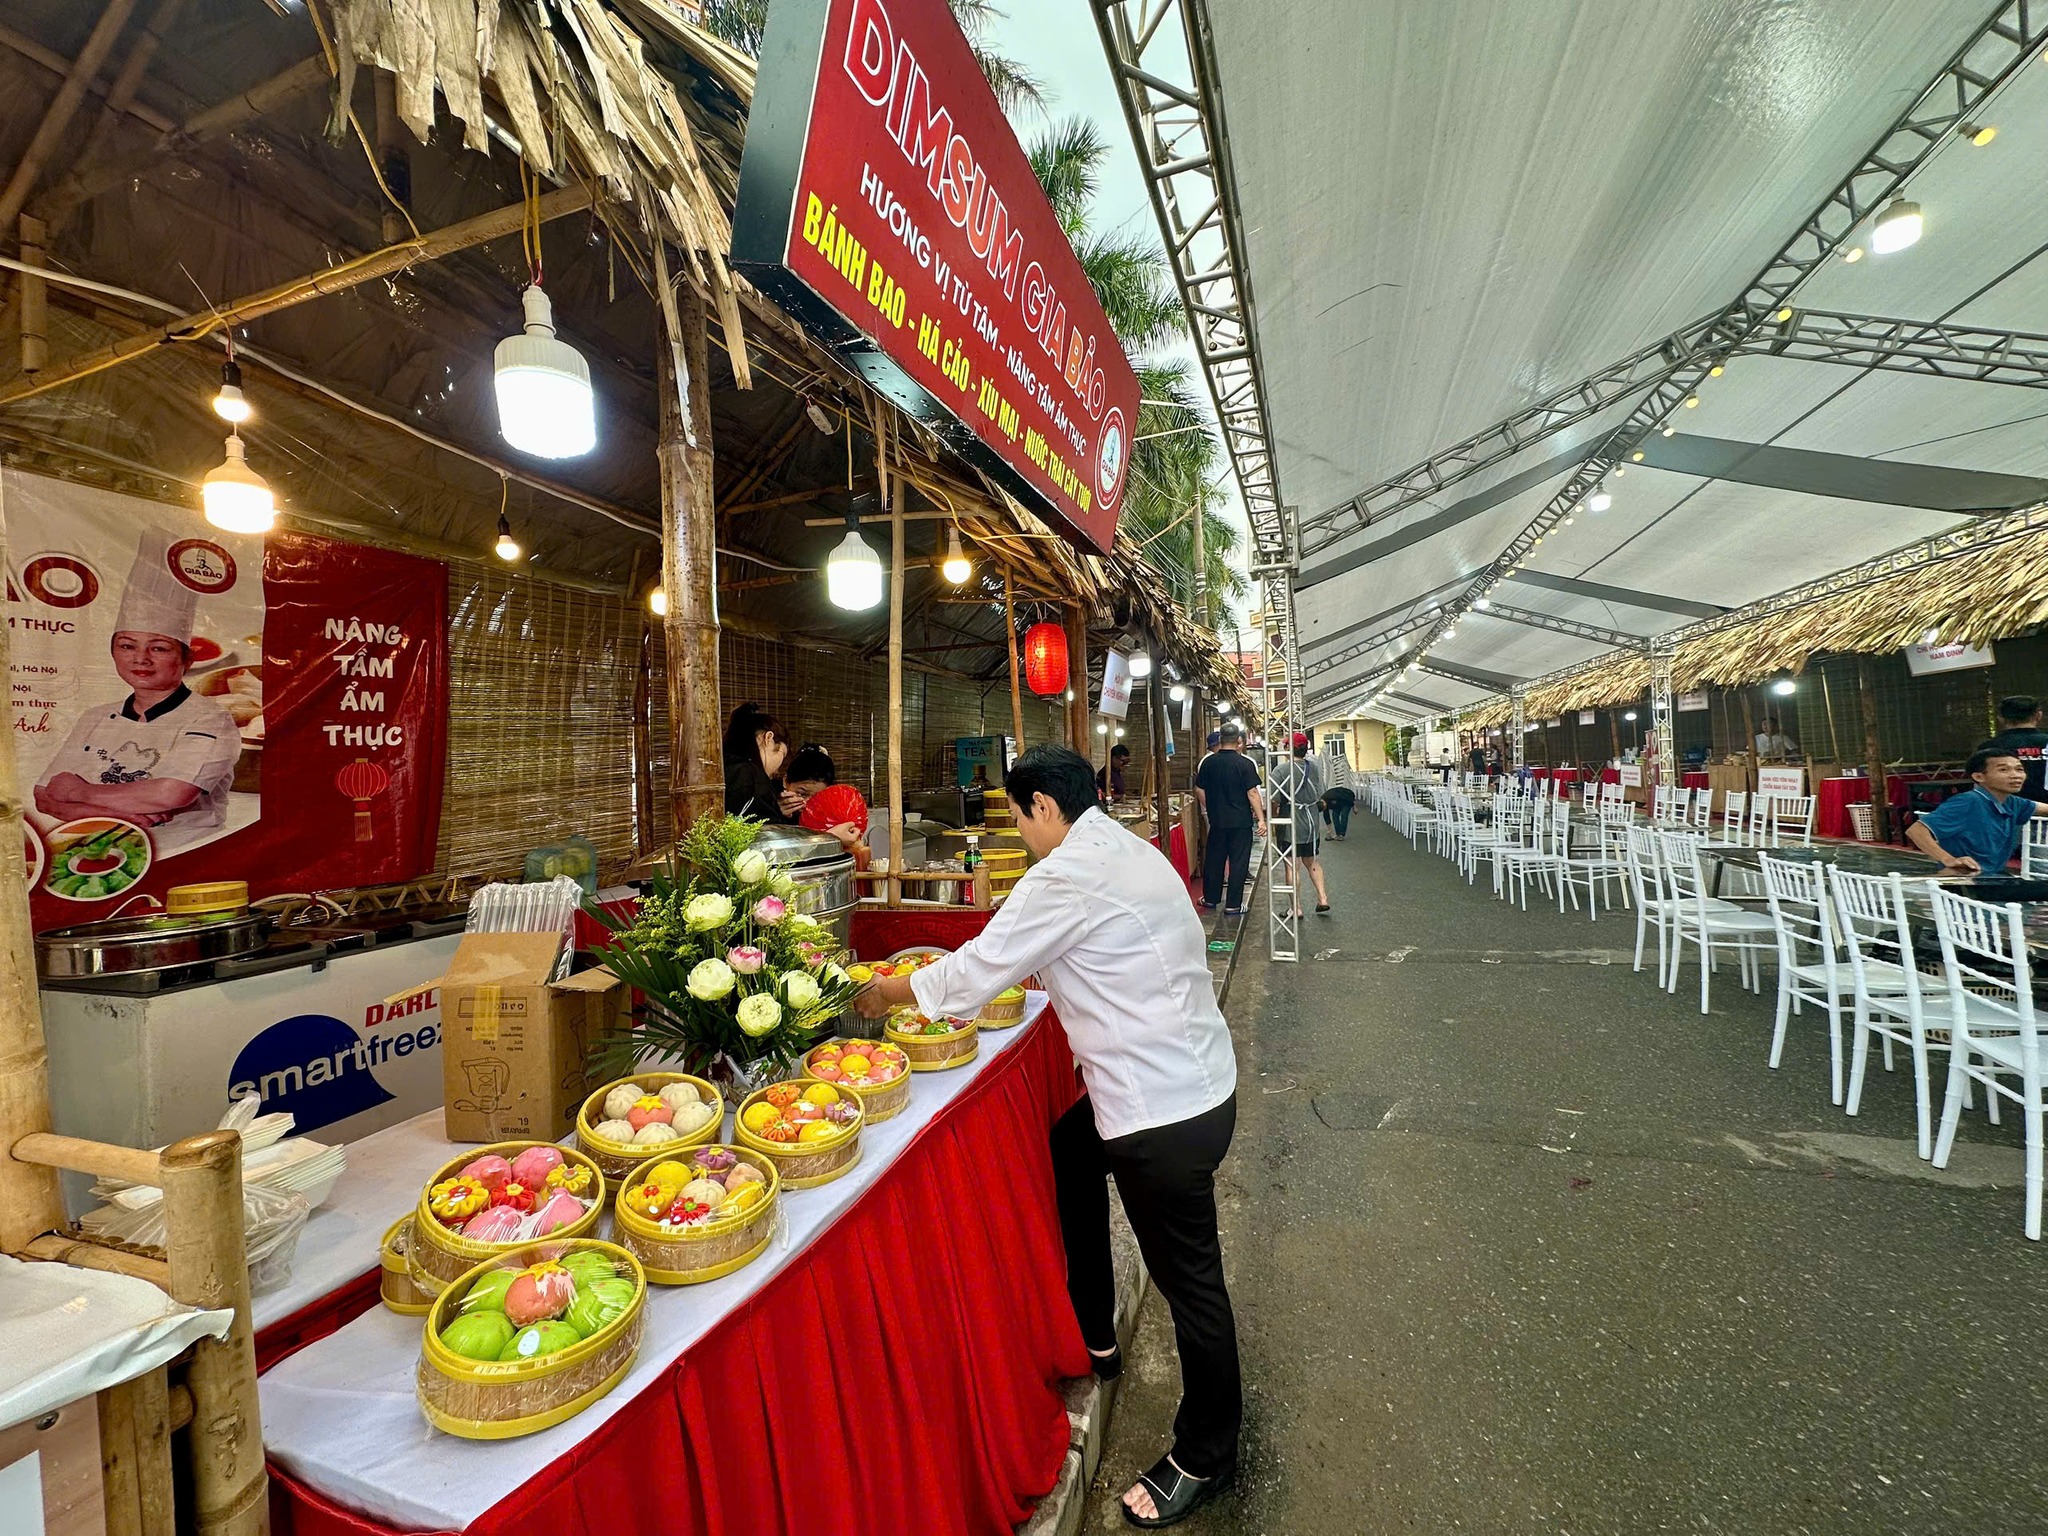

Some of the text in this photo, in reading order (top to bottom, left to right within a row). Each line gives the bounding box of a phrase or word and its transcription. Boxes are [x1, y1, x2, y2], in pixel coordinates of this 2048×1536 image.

[843, 0, 1106, 421] DIMSUM GIA BẢO
[860, 162, 931, 268] HƯƠNG
[935, 252, 950, 301] VỊ
[972, 300, 999, 351] TÂM
[1006, 345, 1037, 396] NÂNG
[803, 190, 867, 292] BÁNH
[867, 259, 906, 329] BAO
[917, 312, 940, 366] HÁ
[941, 337, 970, 393] CẢO
[977, 376, 999, 421] XÍU
[997, 398, 1020, 445] MẠI
[1024, 425, 1049, 471] NƯỚC
[1048, 450, 1066, 489] TRÁI
[1063, 469, 1080, 502] CÂY
[21, 617, 76, 635] THỰC
[325, 616, 402, 645] NÂNG
[23, 665, 39, 673] Hà
[41, 666, 58, 676] Nội
[333, 648, 393, 678] TẦM
[13, 684, 32, 694] Nội
[340, 681, 384, 712] ẨM
[29, 699, 57, 710] thực
[322, 722, 403, 751] THỰC
